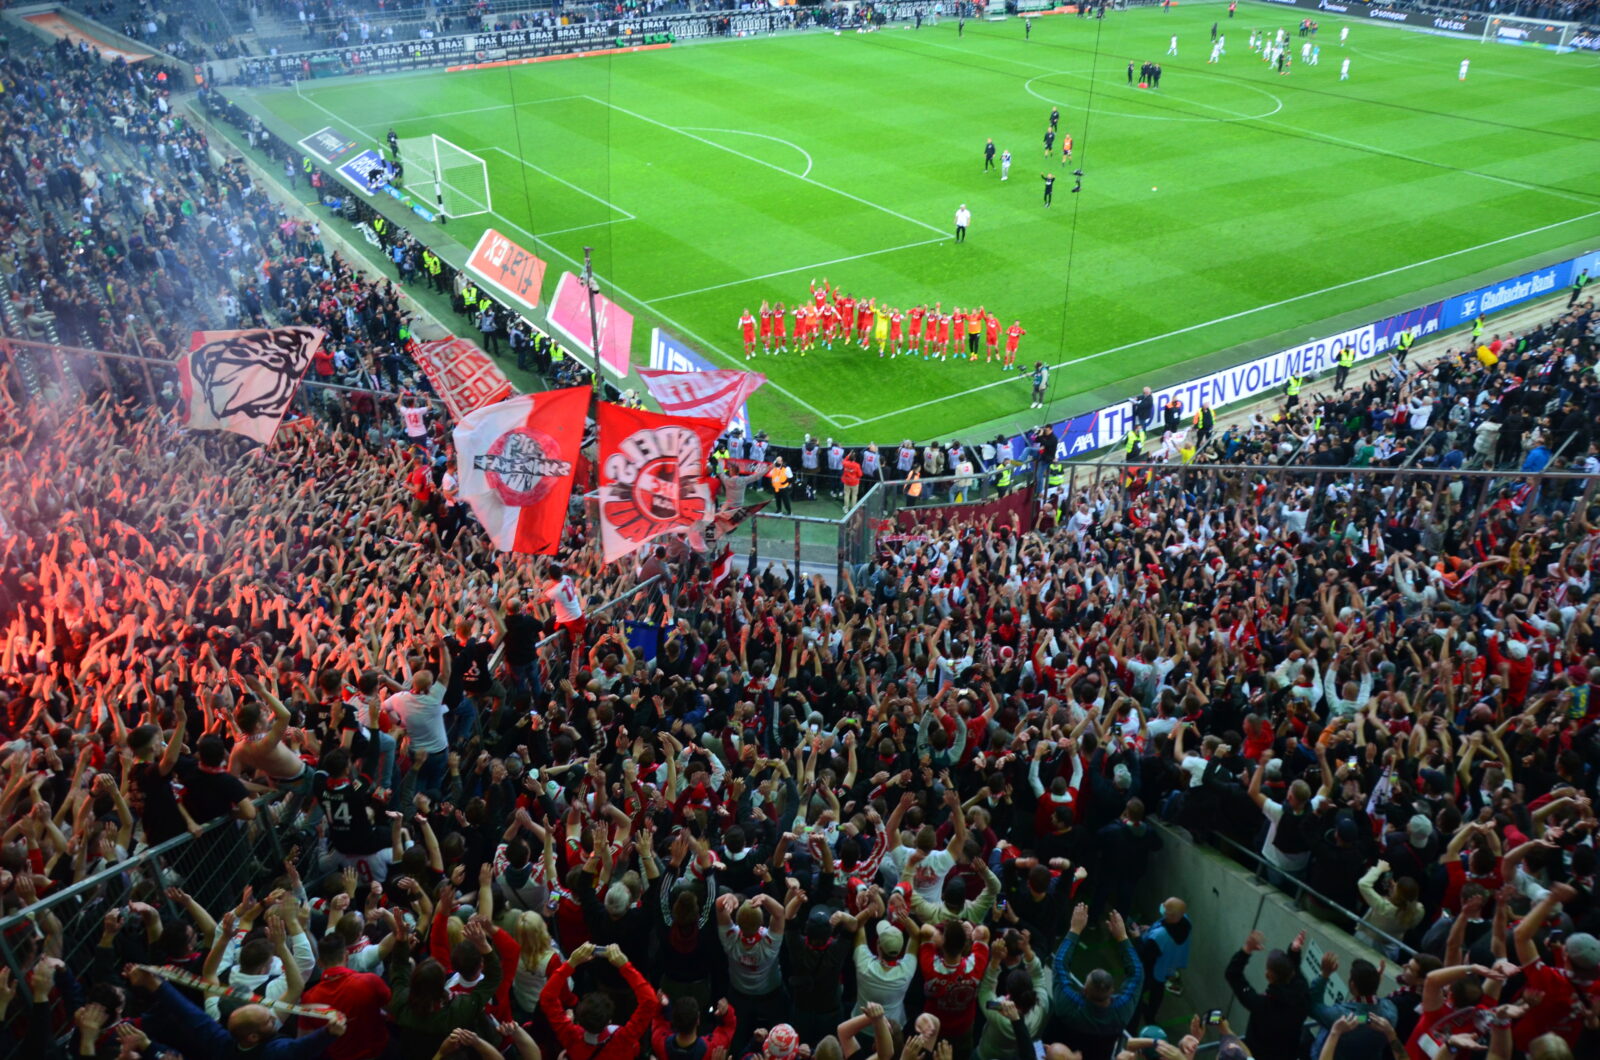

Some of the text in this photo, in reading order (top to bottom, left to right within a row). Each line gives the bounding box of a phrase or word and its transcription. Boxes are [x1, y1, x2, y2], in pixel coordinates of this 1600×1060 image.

[619, 23, 641, 32] BRAX
[643, 21, 664, 30] BRAX
[529, 31, 553, 41] BRAX
[557, 29, 580, 38] BRAX
[501, 34, 525, 44] BRAX
[408, 43, 434, 53] BRAX
[438, 40, 464, 50] BRAX
[377, 46, 404, 57] BRAX
[1480, 270, 1556, 312] Gladbacher Bank
[1232, 343, 1325, 397] VOLLMER
[1070, 432, 1096, 455] AXA
[321, 801, 353, 826] 14
[356, 859, 373, 884] 9
